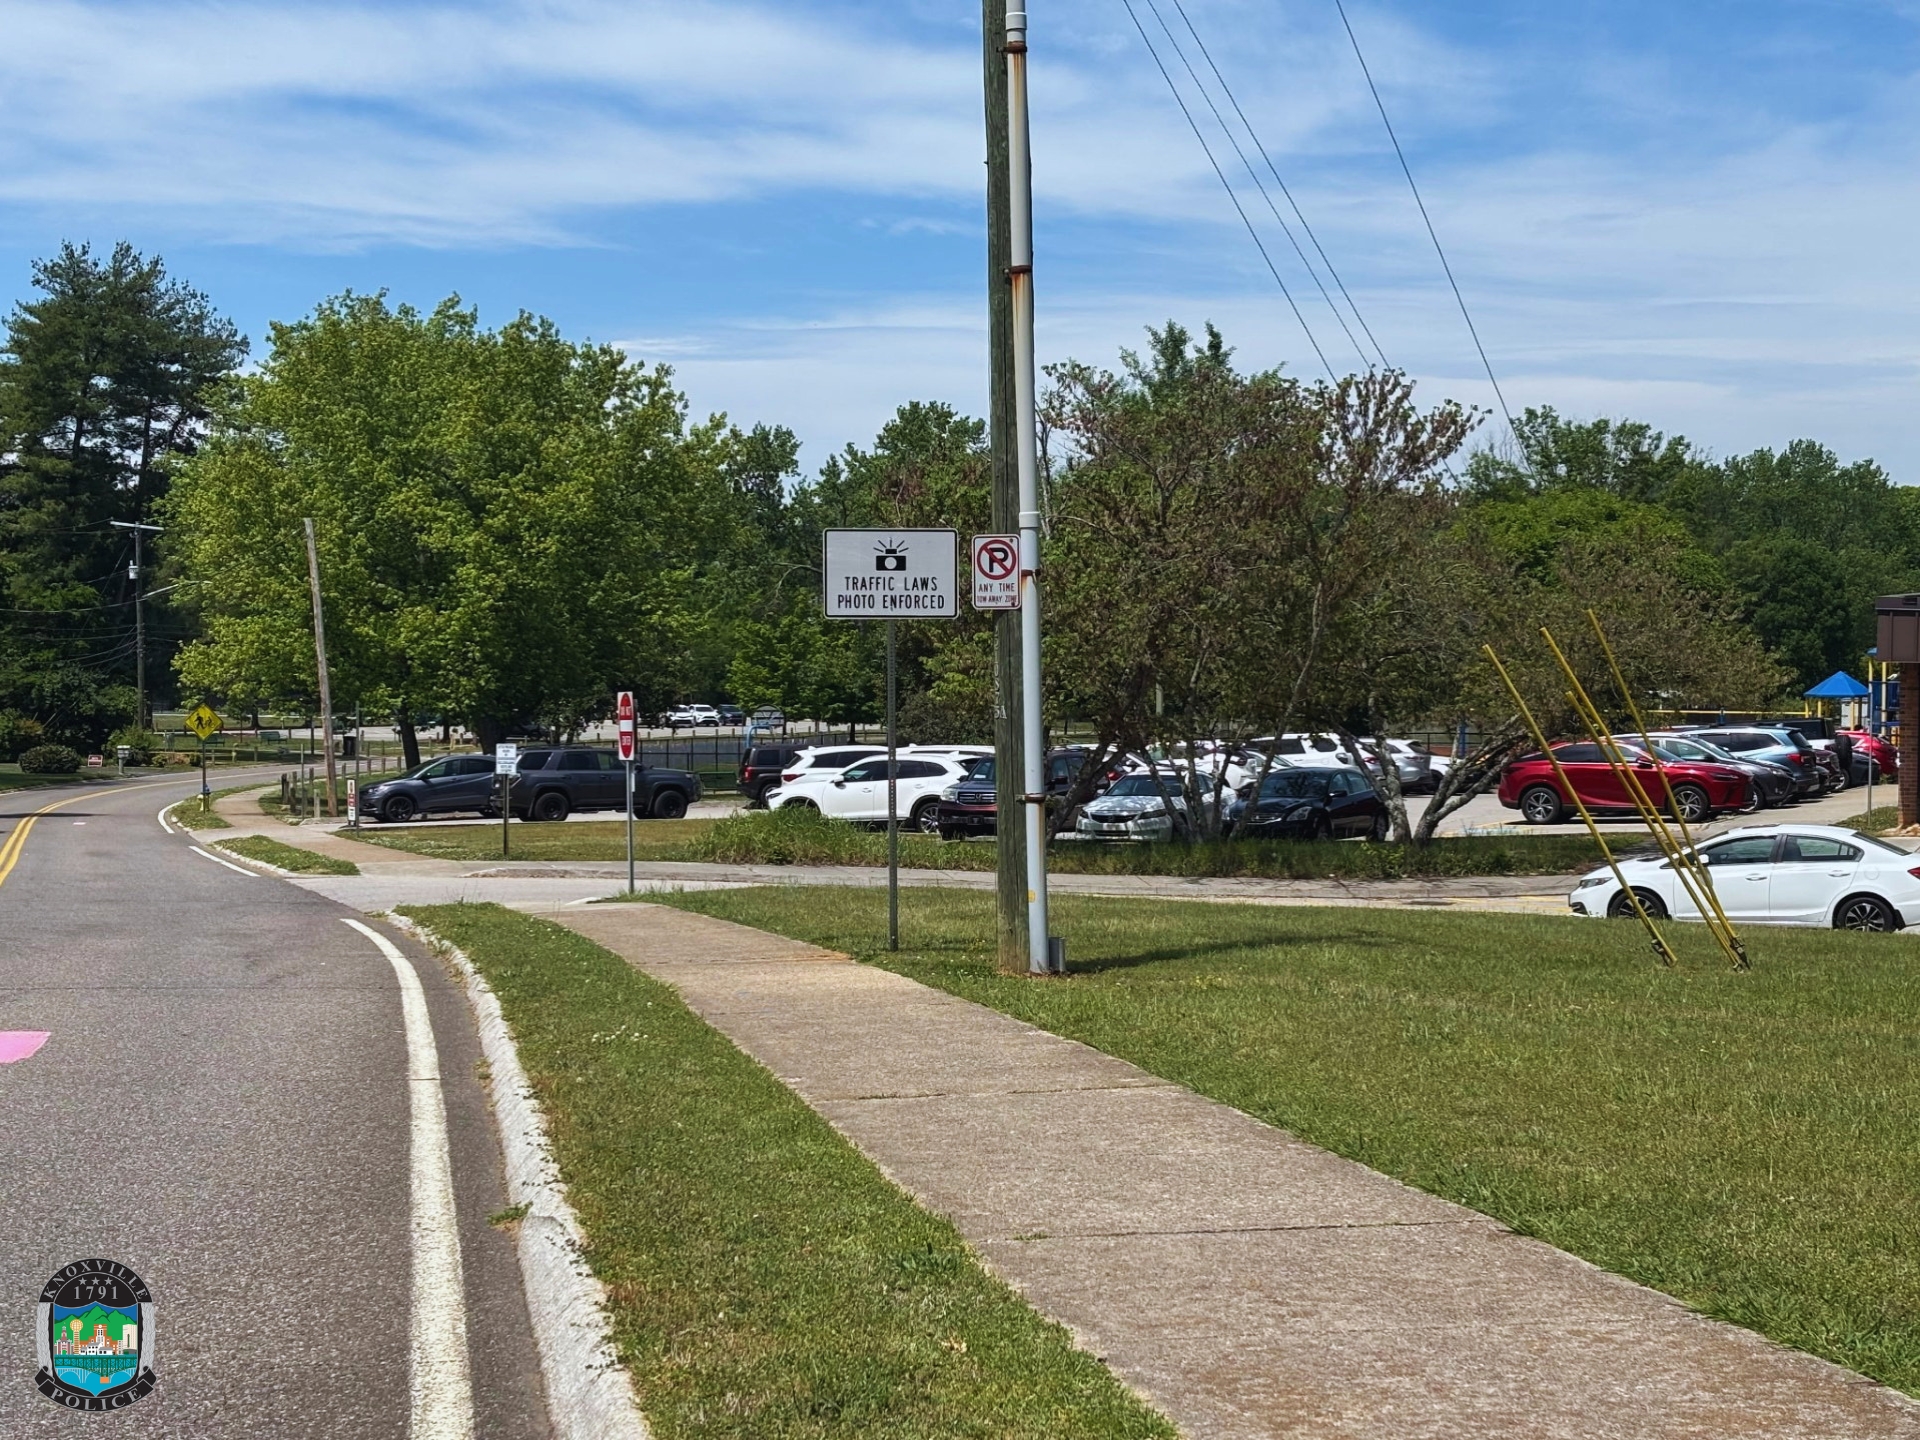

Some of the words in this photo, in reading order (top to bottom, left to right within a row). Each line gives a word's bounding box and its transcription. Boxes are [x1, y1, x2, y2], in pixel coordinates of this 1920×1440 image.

[844, 576, 895, 591] TRAFFIC
[904, 576, 938, 591] LAWS
[978, 583, 993, 593] ANY
[999, 583, 1015, 593] TIME
[837, 594, 875, 609] PHOTO
[882, 594, 945, 609] ENFORCED
[988, 595, 1003, 603] AWAY
